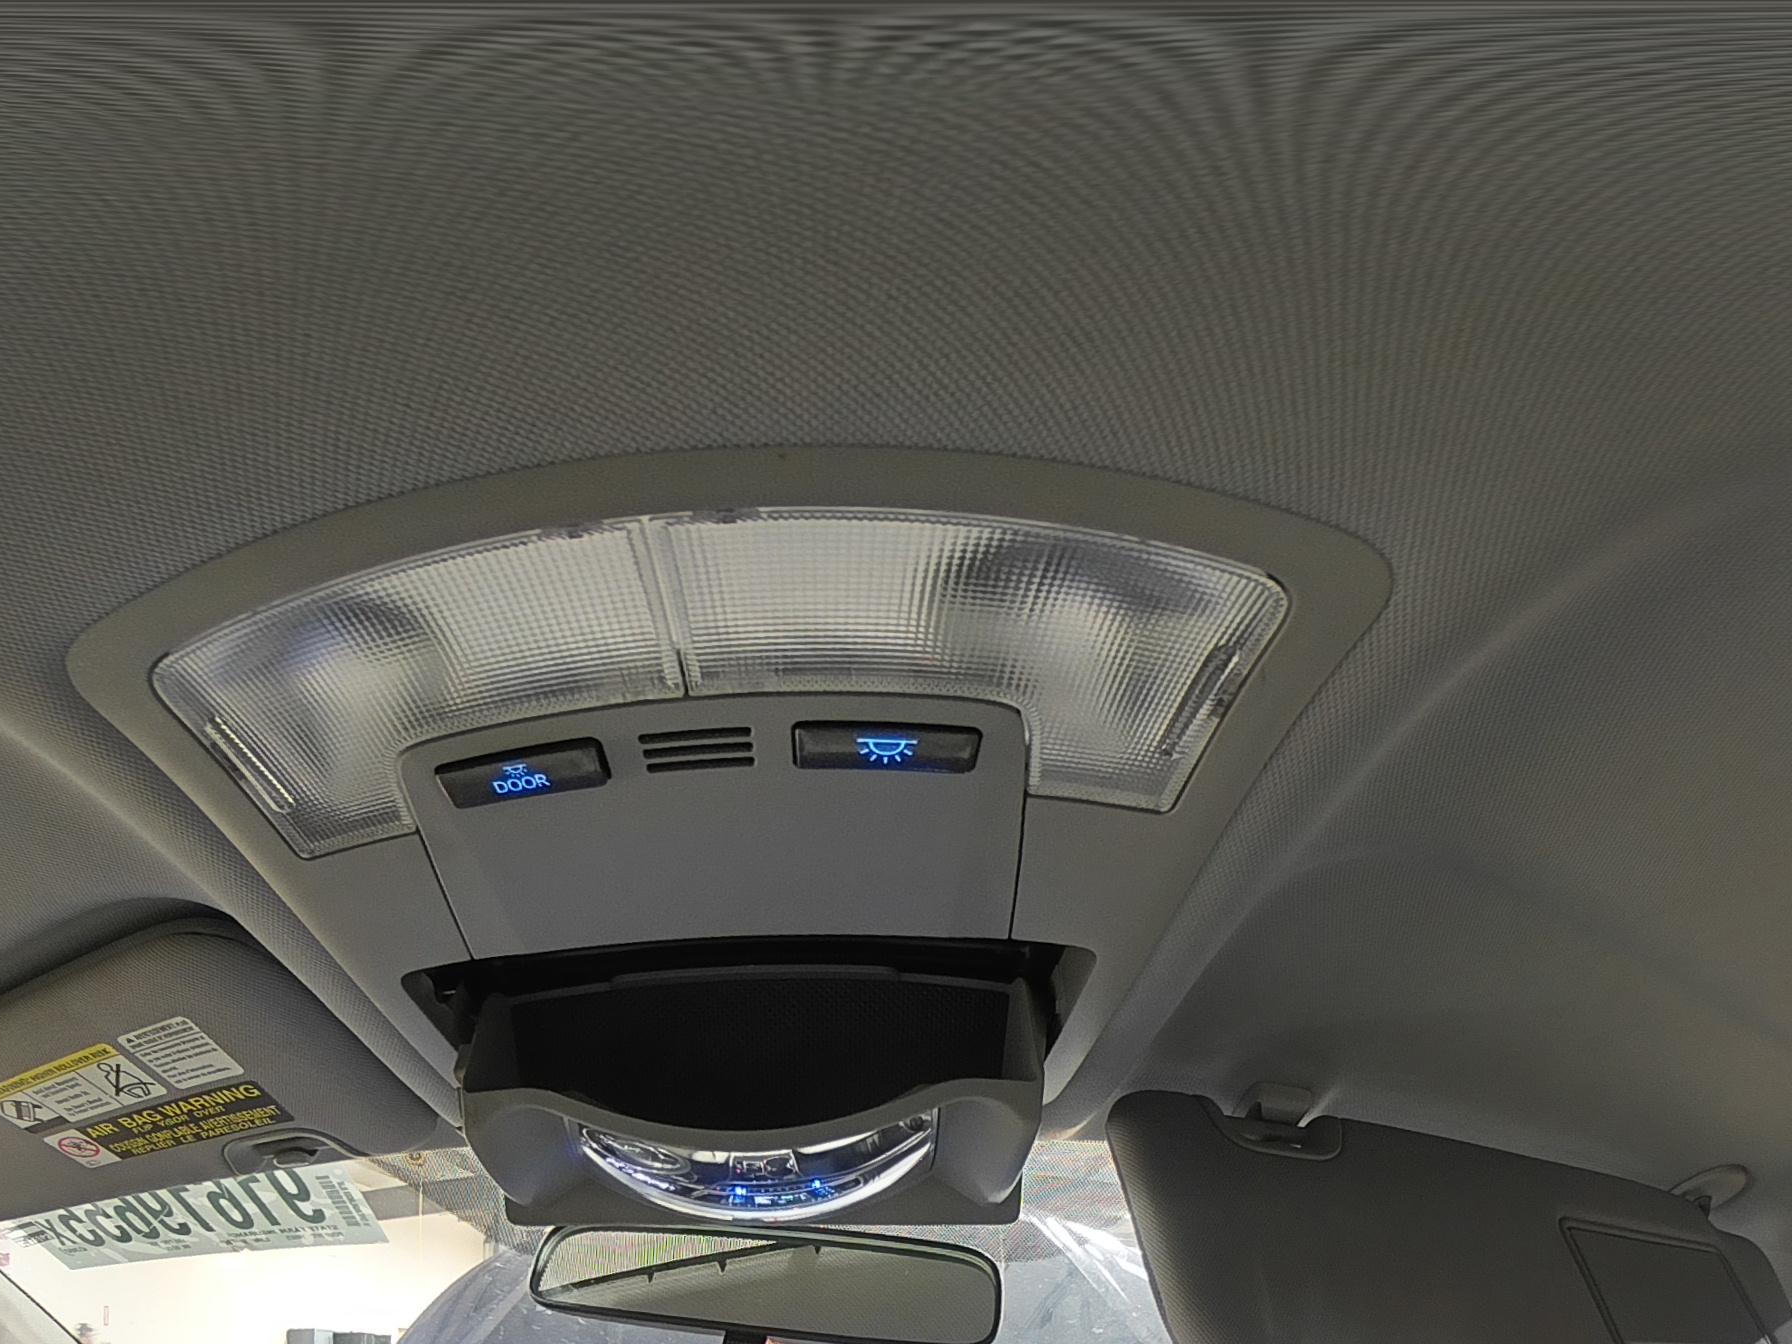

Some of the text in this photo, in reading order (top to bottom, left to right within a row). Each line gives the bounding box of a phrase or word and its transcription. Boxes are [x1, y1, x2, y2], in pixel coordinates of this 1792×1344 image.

[492, 773, 551, 794] DOOR
[86, 1084, 262, 1139] AIR BAG WARNING
[193, 1105, 226, 1118] OVER
[179, 1135, 197, 1144] LE
